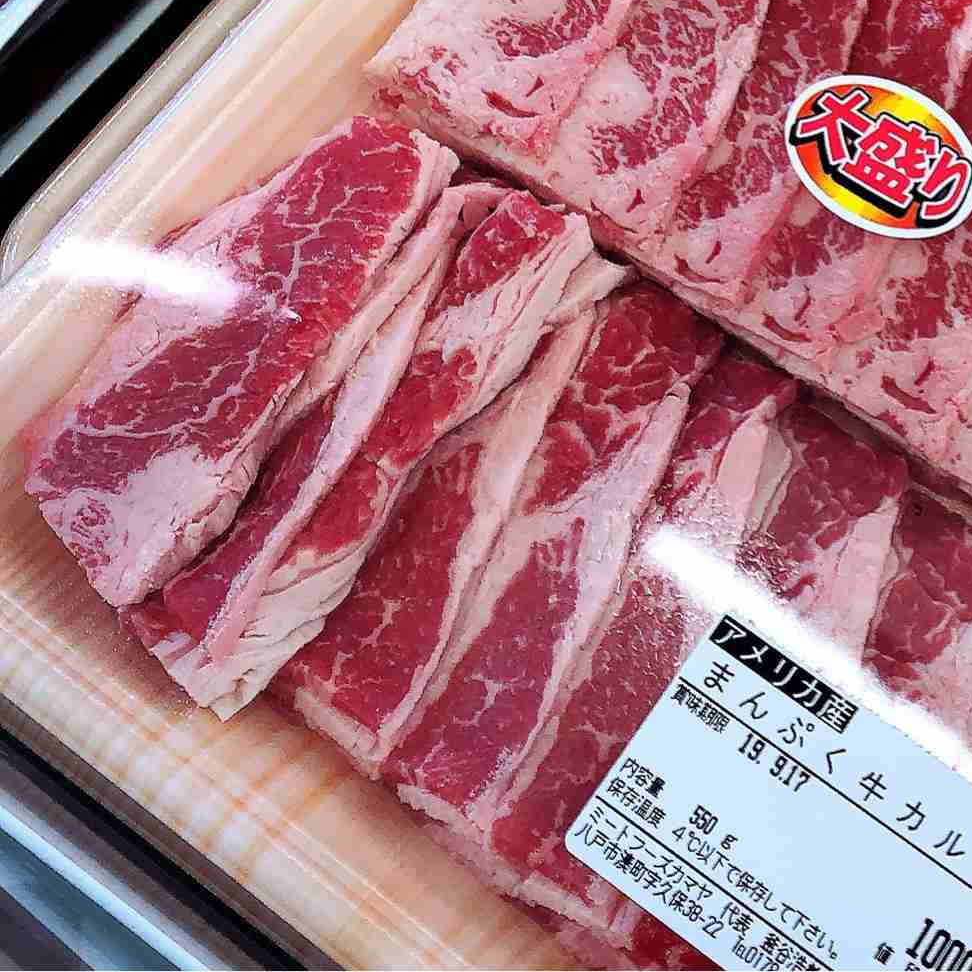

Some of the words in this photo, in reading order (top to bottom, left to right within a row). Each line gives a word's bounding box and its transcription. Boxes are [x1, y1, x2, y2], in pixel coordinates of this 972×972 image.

[713, 618, 858, 734] アメリカ産
[669, 683, 730, 735] 賞味期限
[606, 777, 668, 829] 保存温度
[619, 756, 667, 799] 内容量
[688, 804, 719, 836] 550
[720, 833, 739, 851] g
[589, 805, 714, 901] ミートフーズカマヤ
[720, 901, 754, 937] 代表
